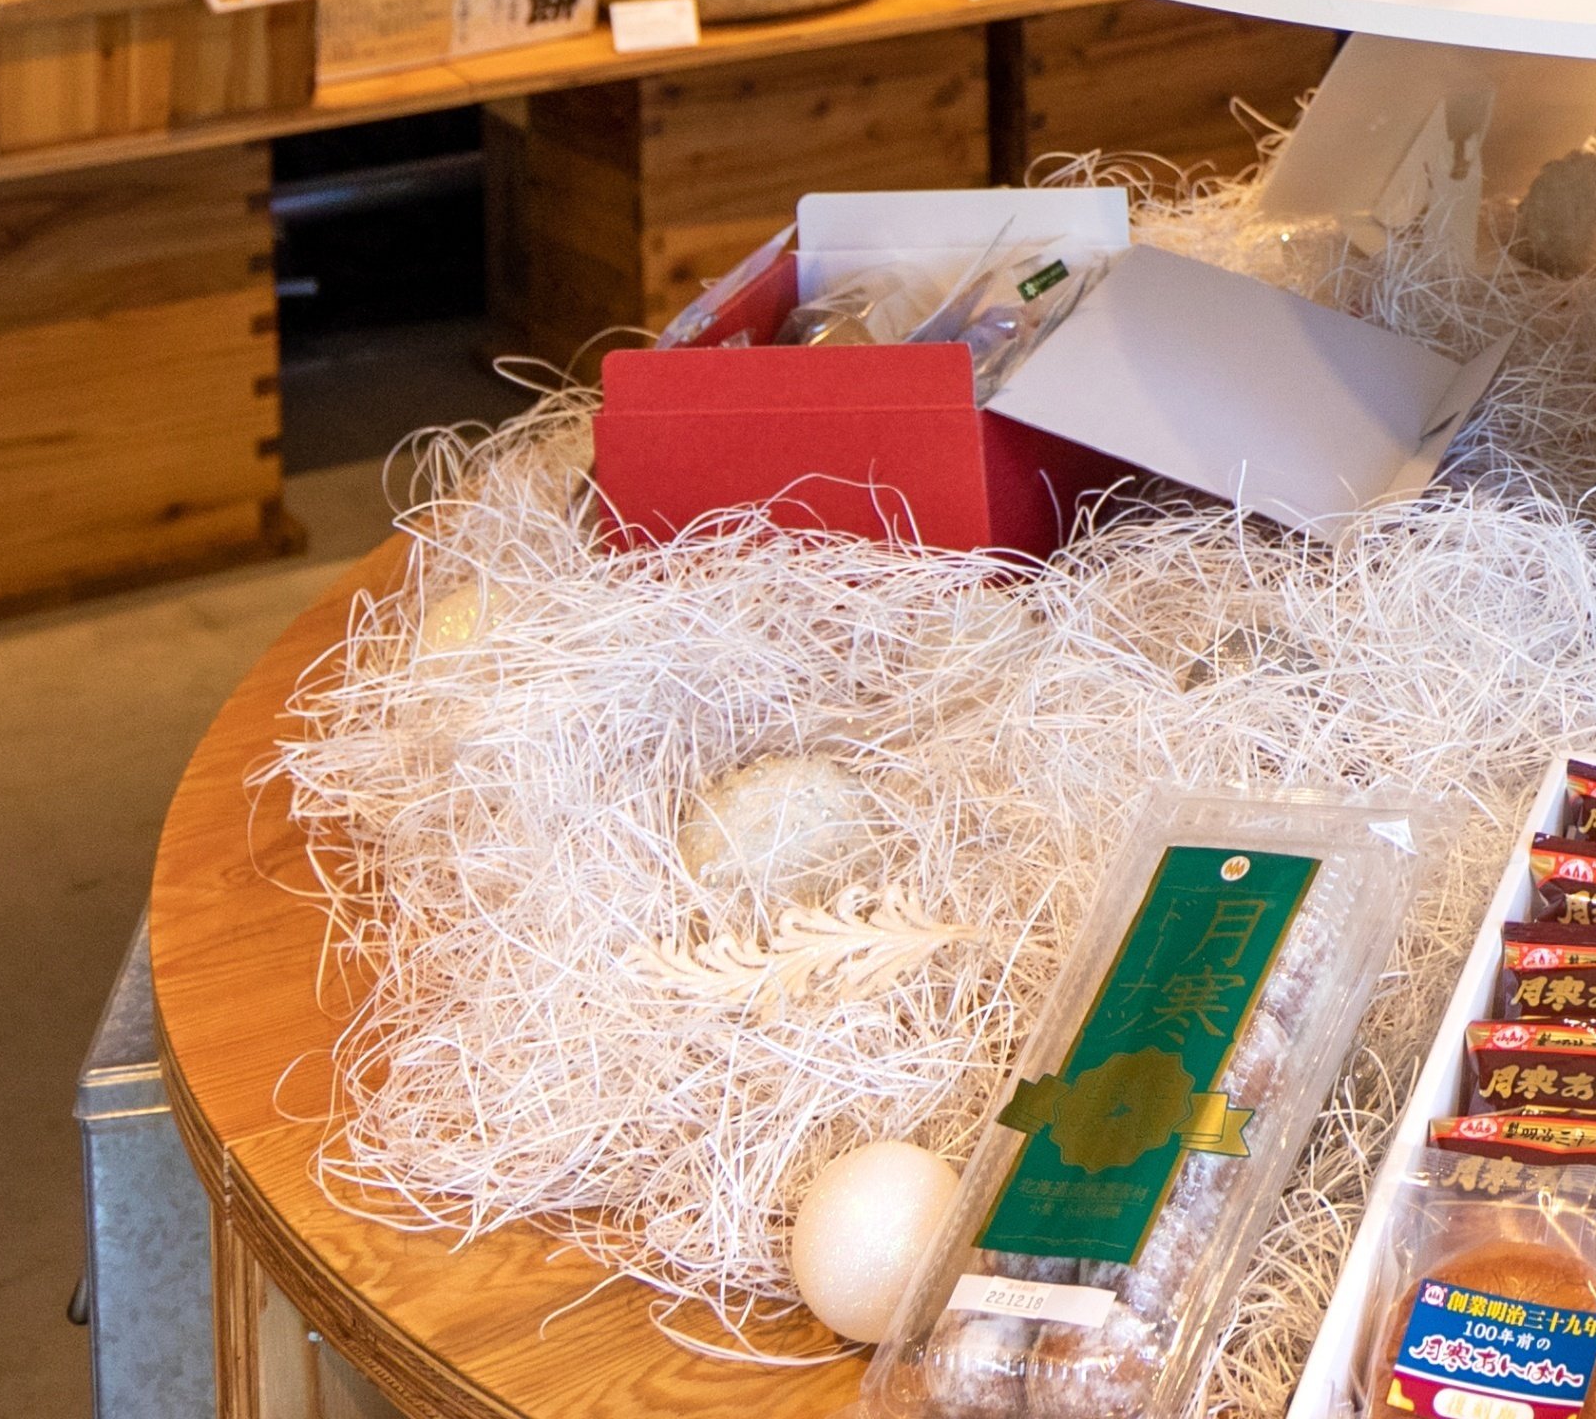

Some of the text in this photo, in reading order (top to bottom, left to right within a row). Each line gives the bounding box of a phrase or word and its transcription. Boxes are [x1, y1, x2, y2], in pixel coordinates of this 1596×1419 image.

[1104, 897, 1199, 1039] ドーナツ
[1152, 898, 1277, 1045] 月寒
[985, 1289, 1045, 1311] 221218
[1409, 1334, 1584, 1387] 月寒あんぱん
[1462, 1320, 1551, 1351] 100年前の
